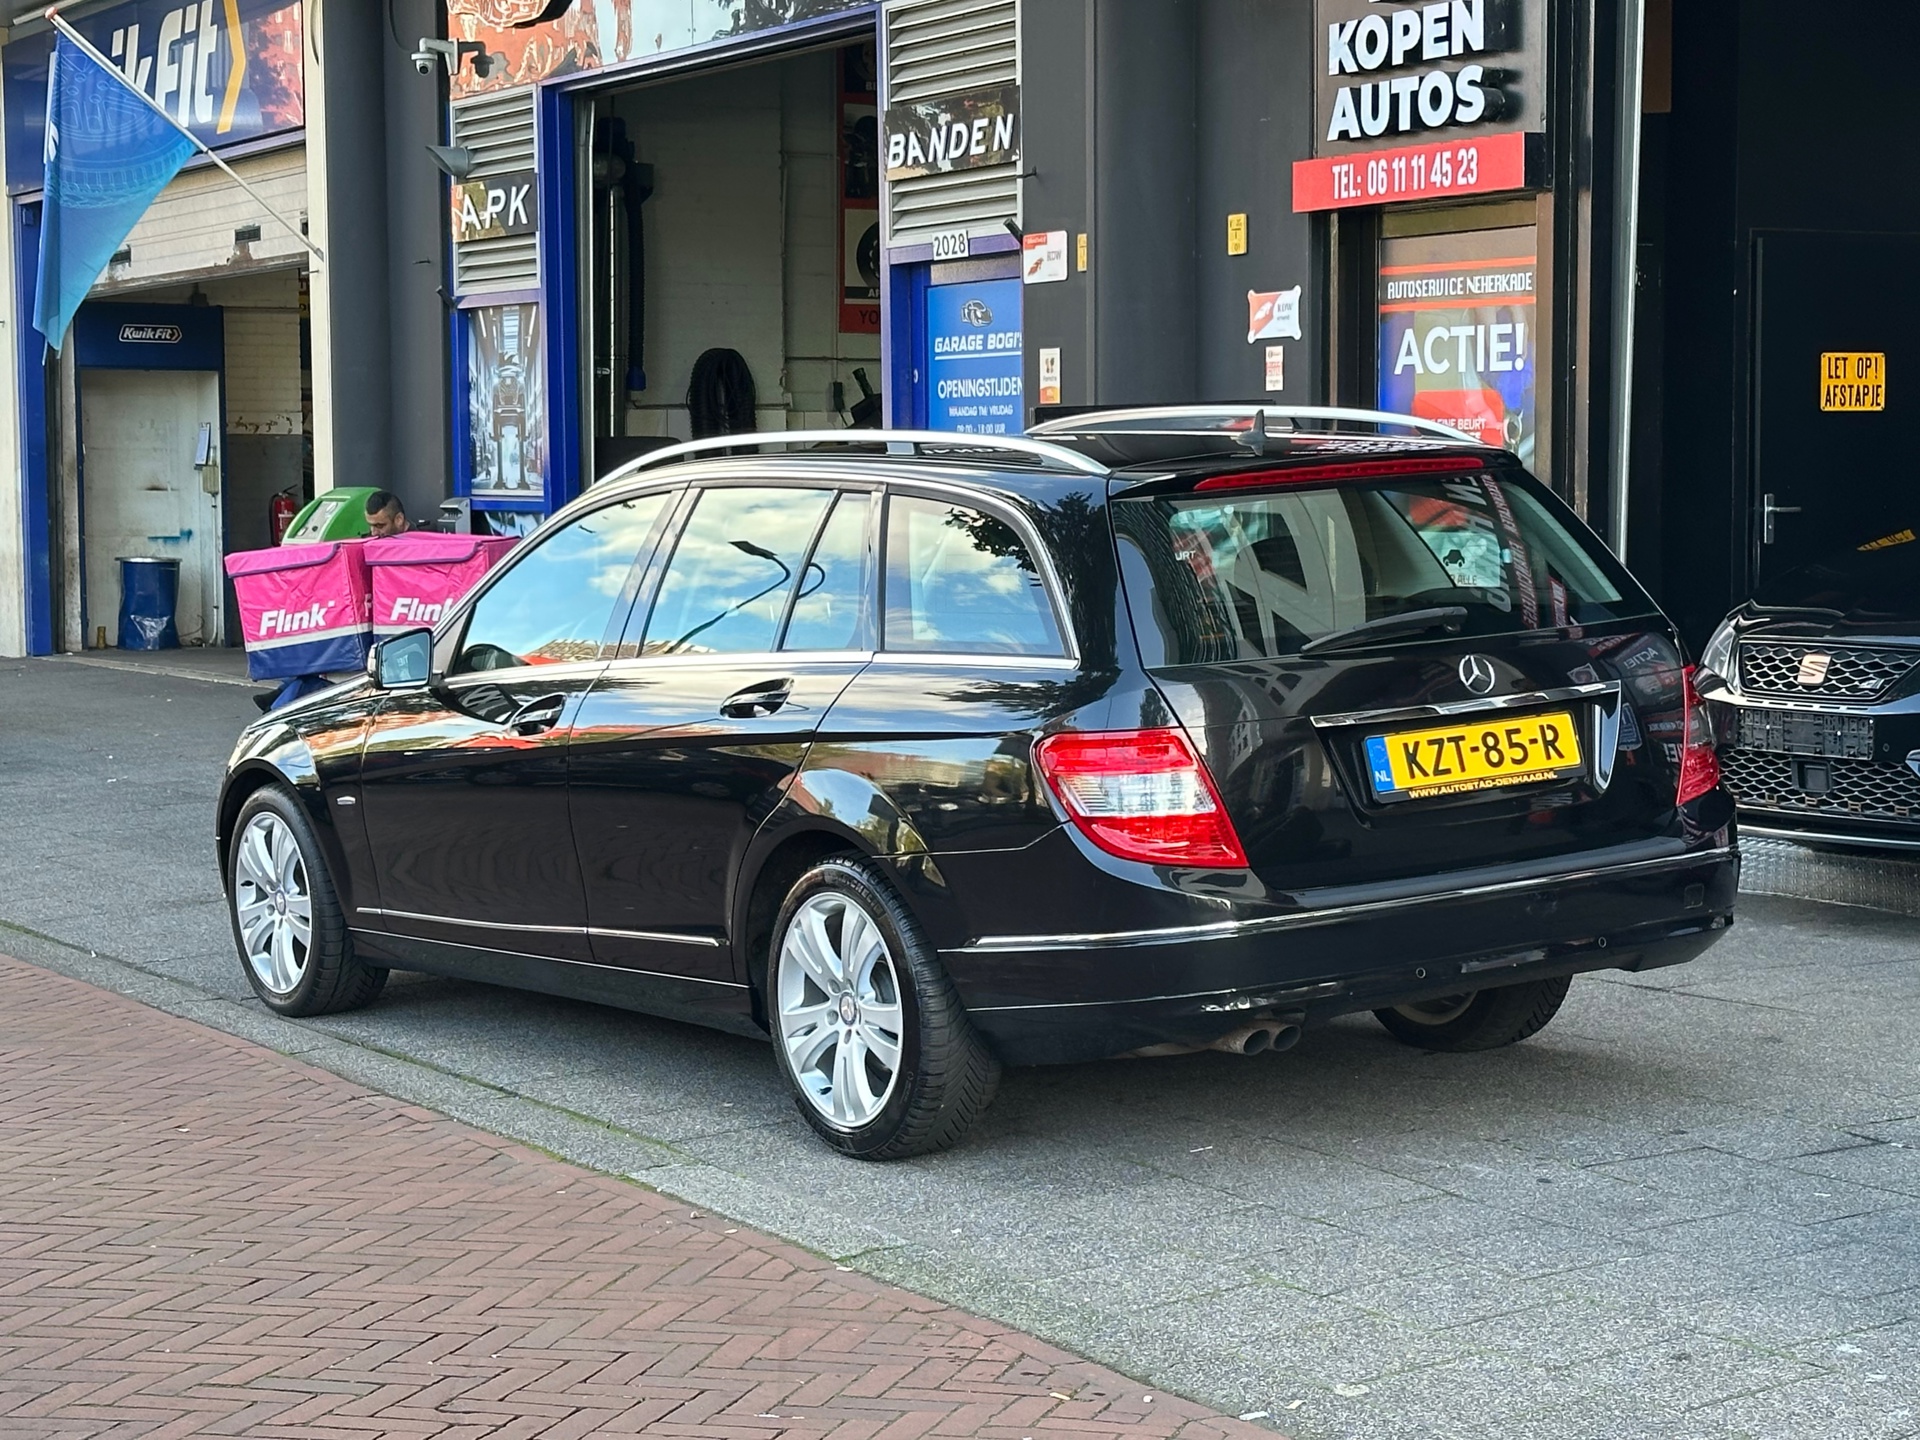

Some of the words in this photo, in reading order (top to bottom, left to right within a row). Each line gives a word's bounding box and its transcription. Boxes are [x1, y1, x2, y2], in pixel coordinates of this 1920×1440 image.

[1328, 0, 1485, 76] KOPEN
[1326, 65, 1486, 142] AUTOS
[886, 113, 1015, 169] BANDEN
[1332, 165, 1362, 200] TEL:
[1367, 160, 1388, 195] 06
[1392, 156, 1407, 193] 11
[1411, 154, 1426, 190] 11
[1429, 150, 1452, 187] 45
[1456, 147, 1478, 185] 23
[460, 183, 530, 232] APK
[934, 233, 965, 257] 2028
[1387, 277, 1464, 300] AUTOSERVICE
[1466, 272, 1533, 295] NEHERKADE
[934, 334, 984, 354] GARAGE
[1394, 322, 1525, 375] ACTIE!
[1827, 356, 1848, 379] LET
[1856, 356, 1879, 379] OP!
[1825, 384, 1882, 407] AFSTAPJE
[1457, 417, 1486, 430] BEURT
[1374, 771, 1391, 783] NL
[1403, 723, 1564, 780] KZT-85-R
[1408, 771, 1558, 799] WWW.AUTOSTAD-DENHAAG.NL
